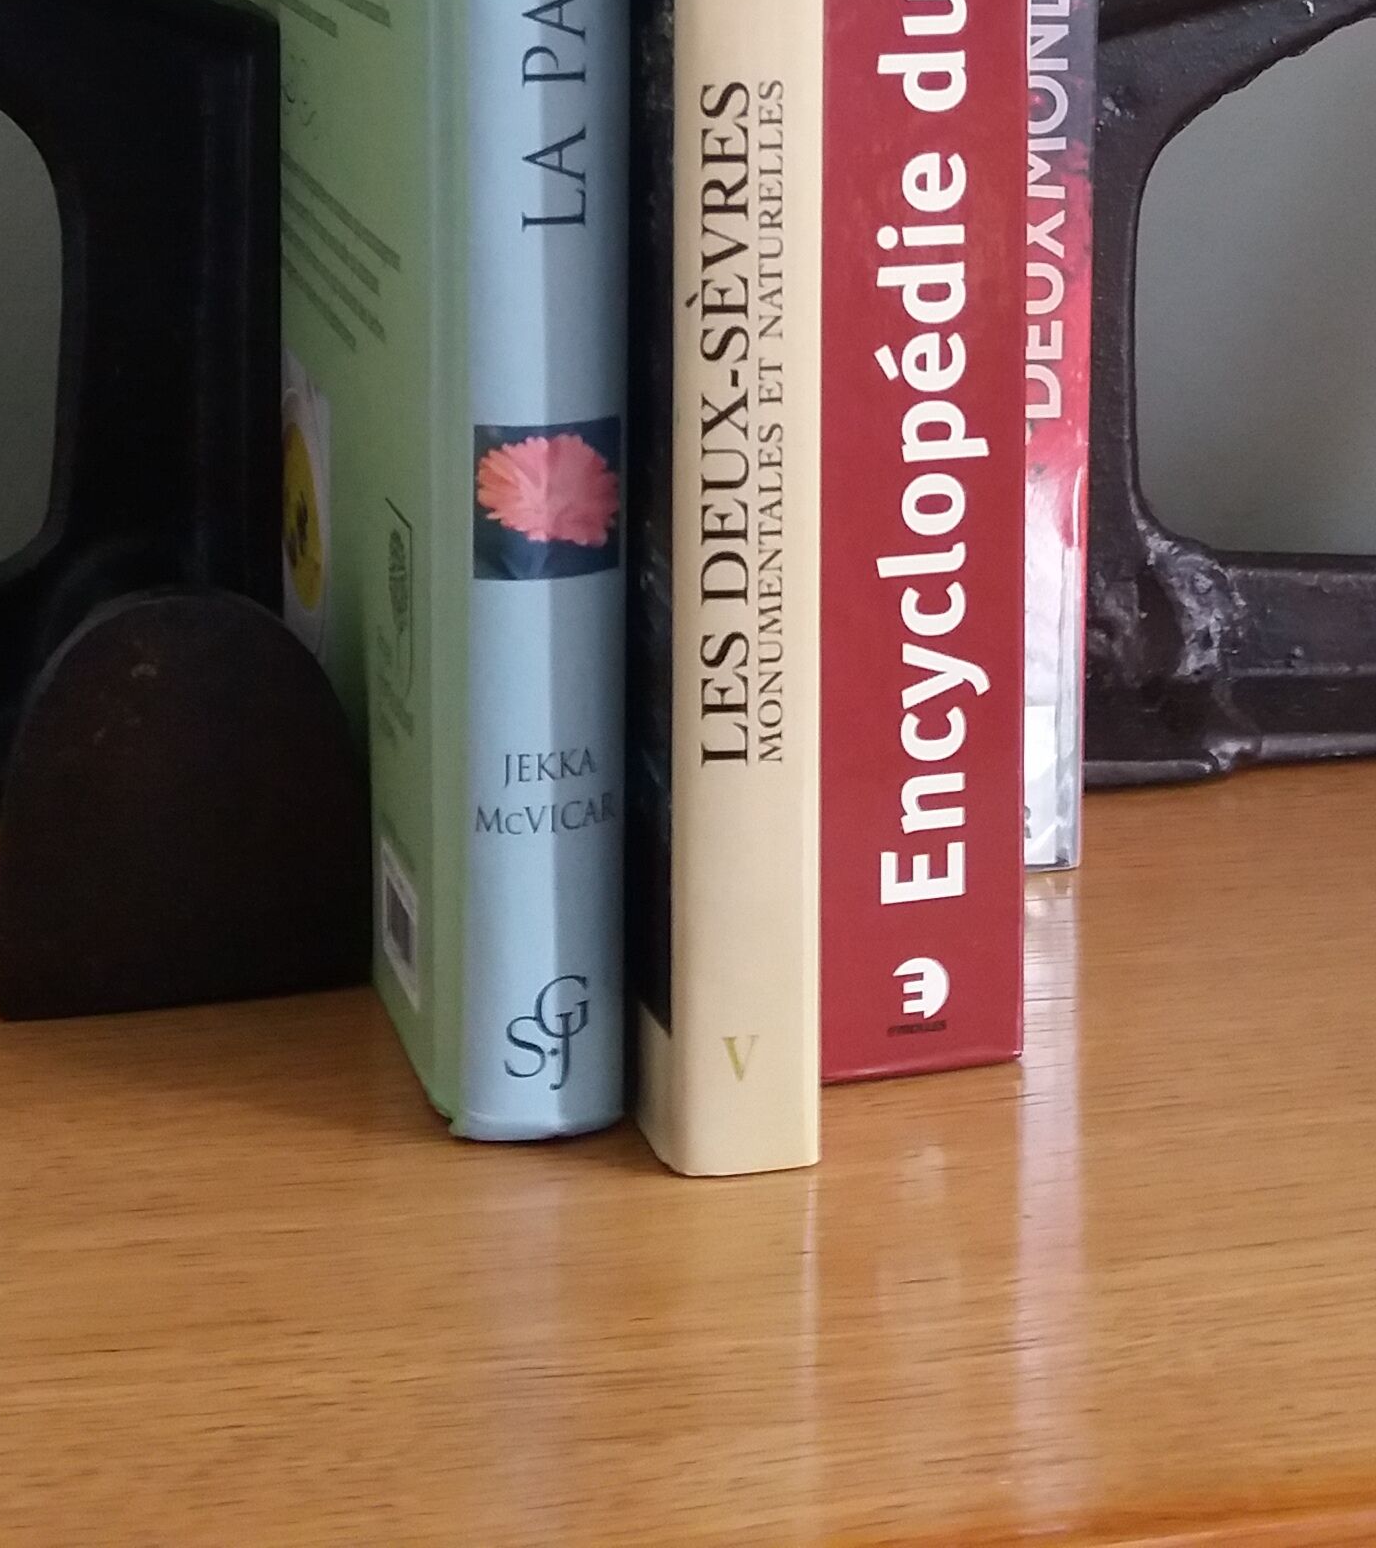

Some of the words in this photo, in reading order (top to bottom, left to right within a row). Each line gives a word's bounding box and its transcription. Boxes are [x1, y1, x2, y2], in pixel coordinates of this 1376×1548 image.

[520, 126, 586, 232] LA
[757, 79, 784, 340] NATURELLES
[685, 81, 750, 605] DEUX-SÈVRES
[757, 357, 784, 406] ET
[757, 422, 784, 764] MONUMENTALES
[874, 151, 990, 906] Encyclopédie
[503, 747, 598, 788] JEKKA
[700, 631, 750, 768] LES
